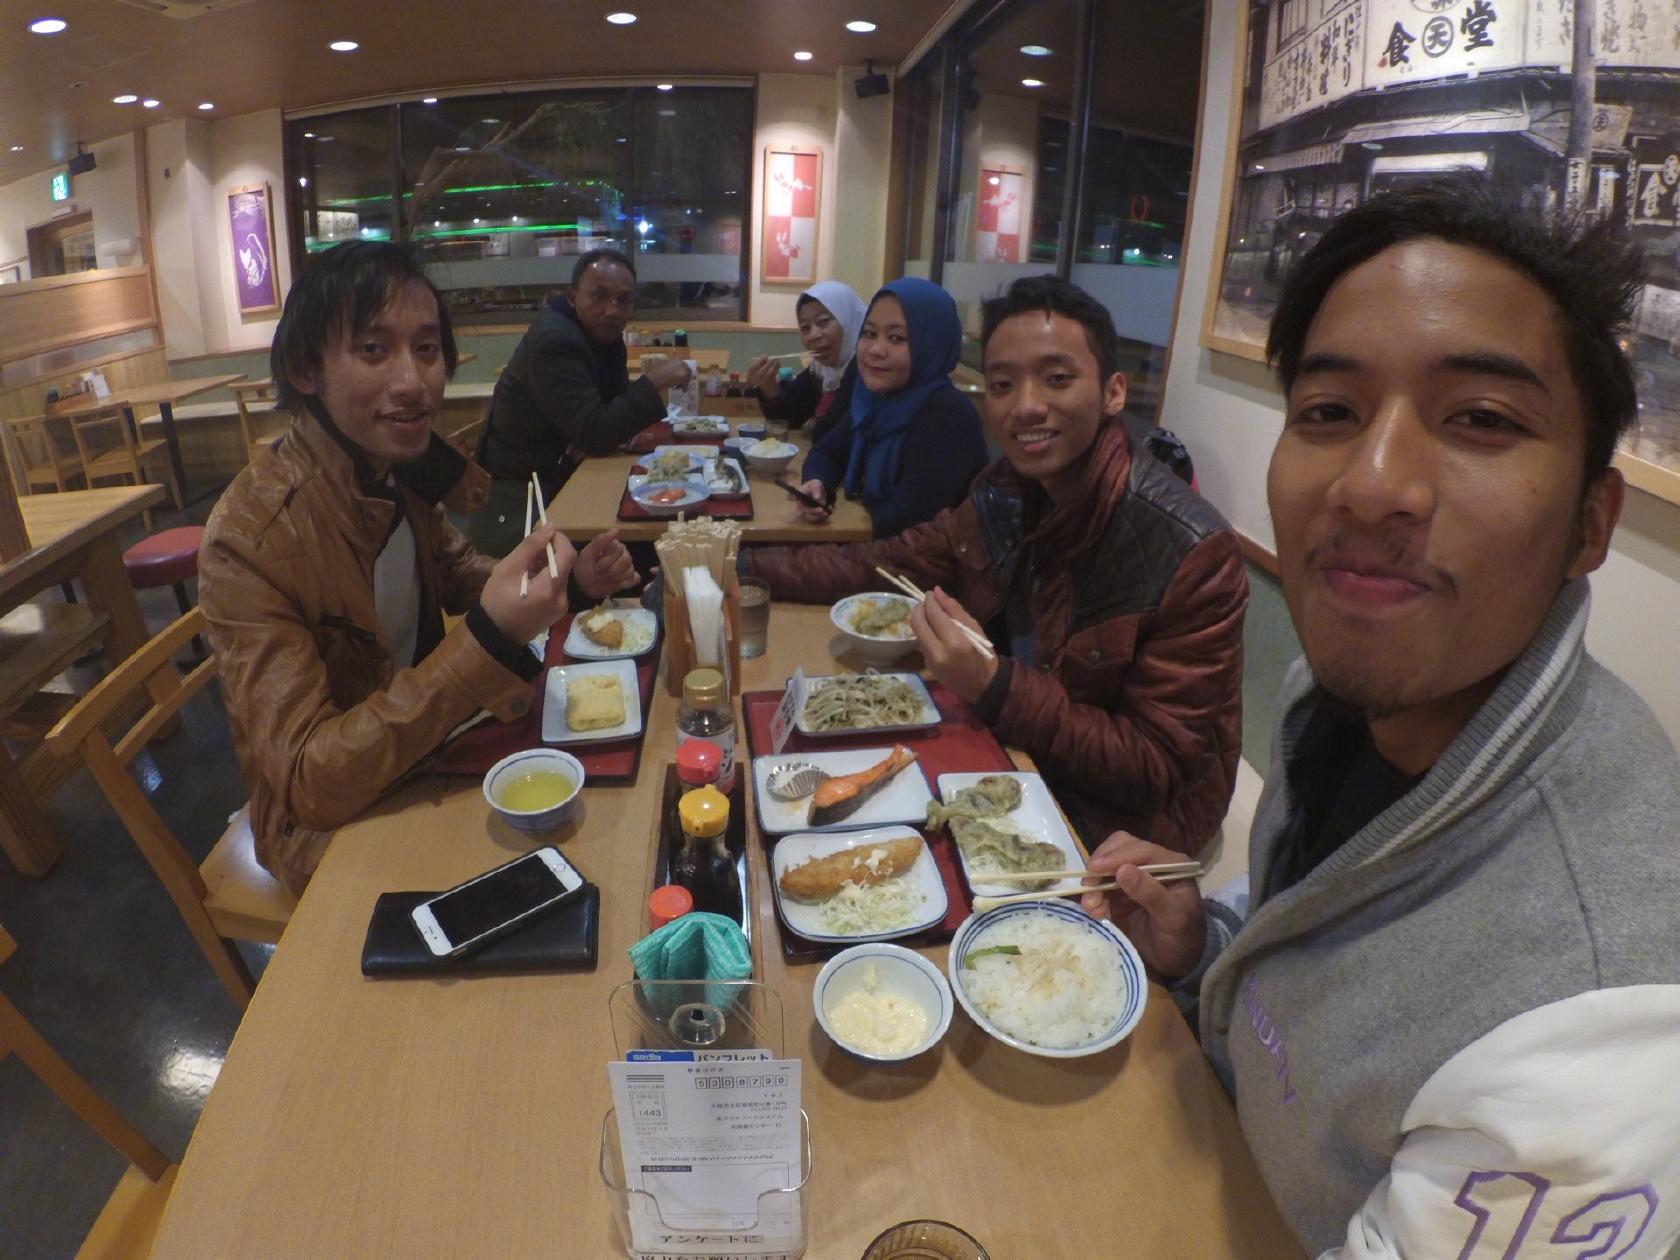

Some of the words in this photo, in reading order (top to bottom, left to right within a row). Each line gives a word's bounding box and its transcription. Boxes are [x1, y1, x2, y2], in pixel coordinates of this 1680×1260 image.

[638, 1109, 662, 1118] 1443
[659, 1234, 762, 1245] アンケートに
